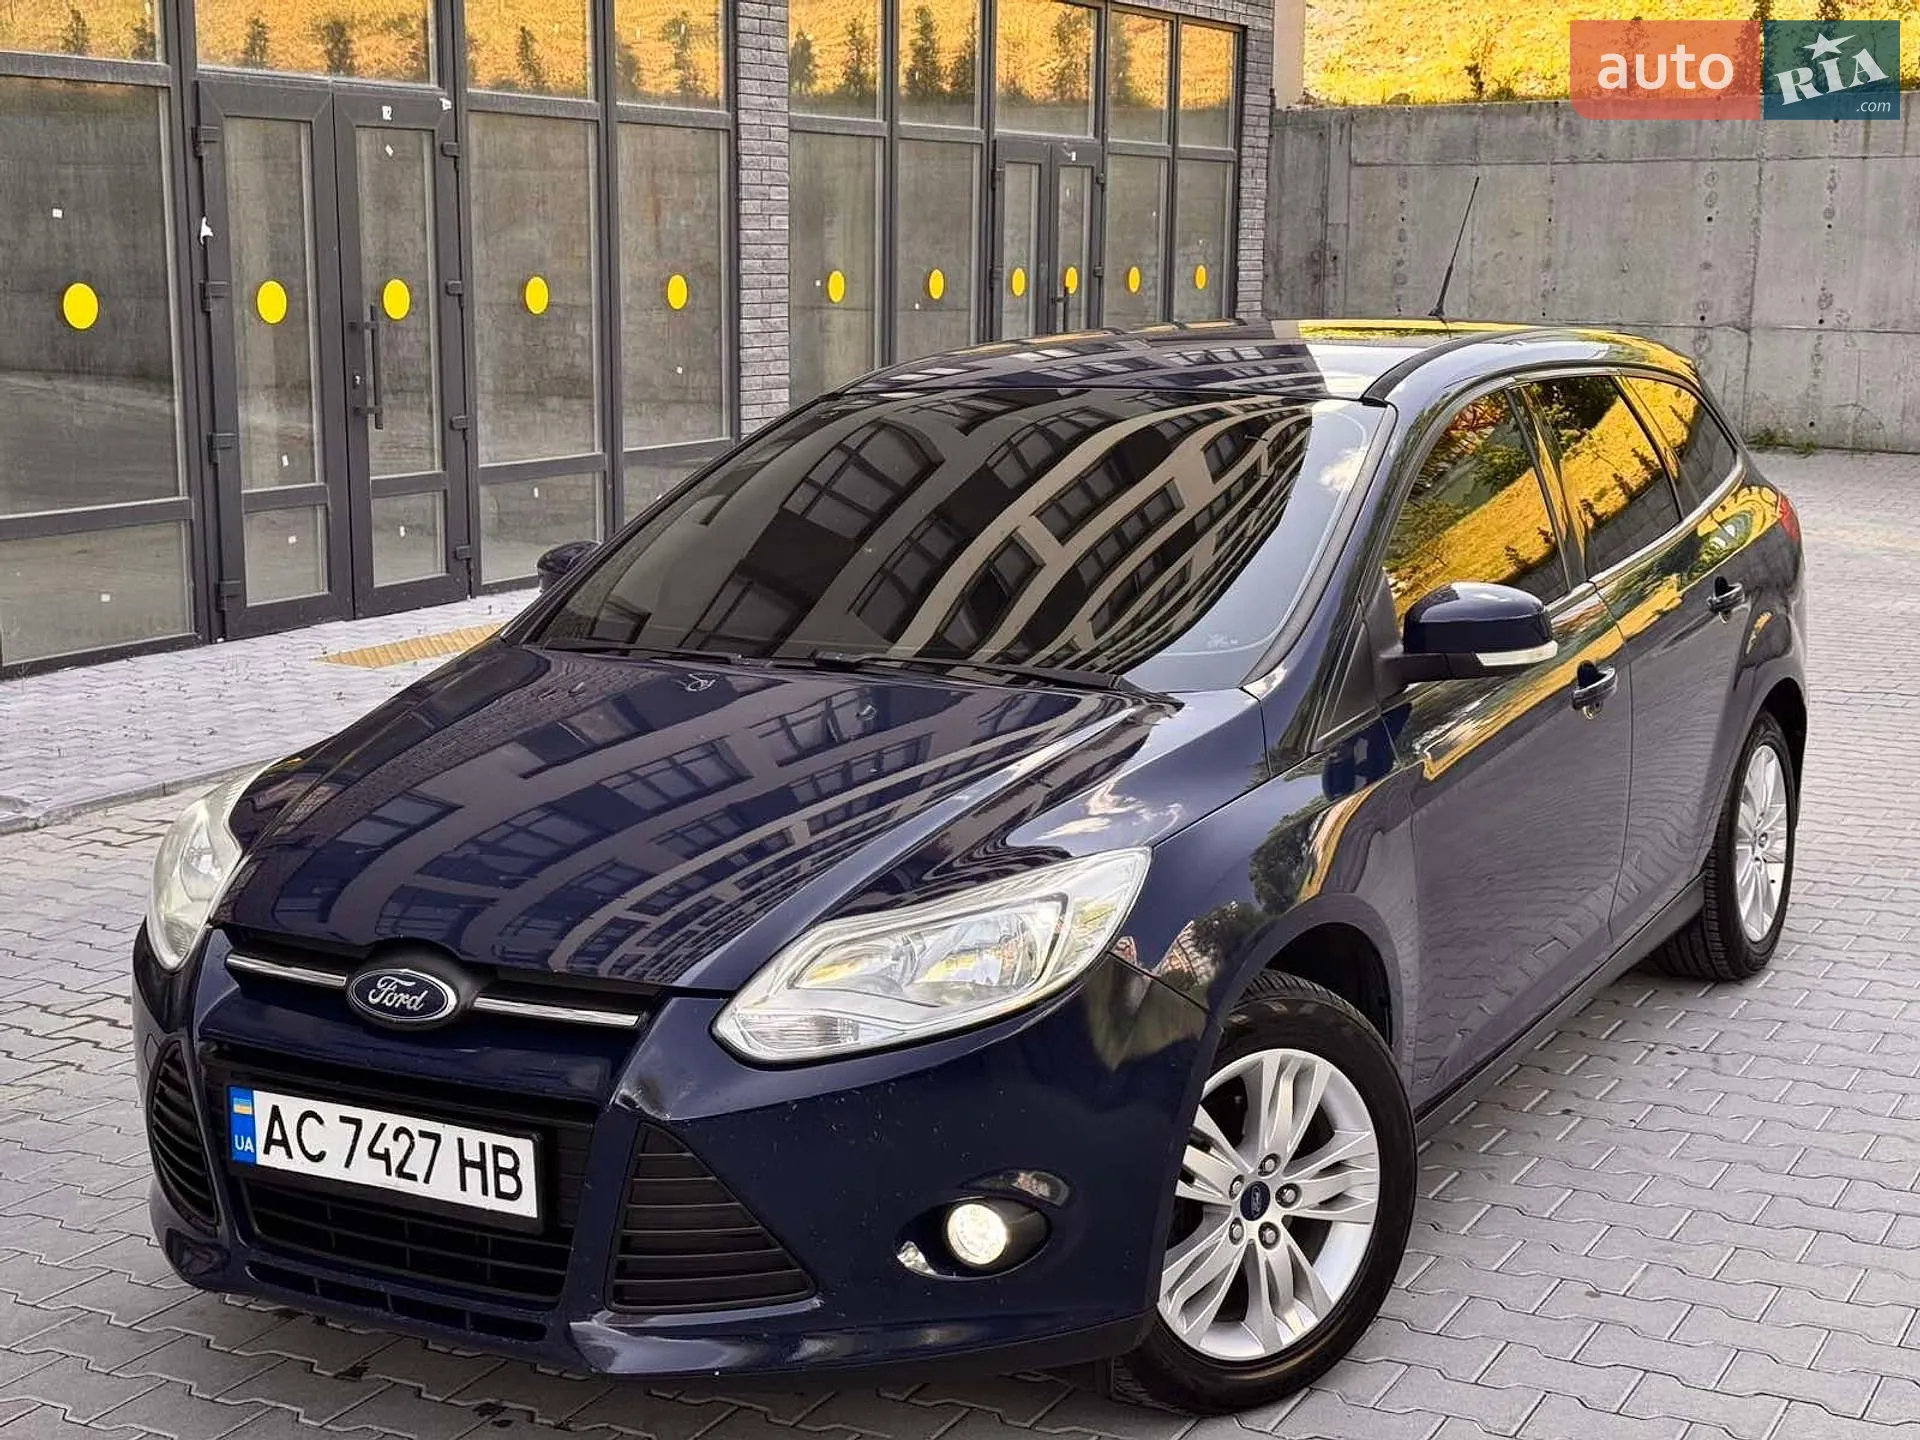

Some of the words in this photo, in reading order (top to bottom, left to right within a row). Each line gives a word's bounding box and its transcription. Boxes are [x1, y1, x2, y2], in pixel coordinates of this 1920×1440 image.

[368, 976, 428, 1011] Ford
[234, 1134, 255, 1153] UA
[263, 1105, 326, 1163] AC
[339, 1115, 442, 1185] 7427
[457, 1138, 522, 1201] HB
